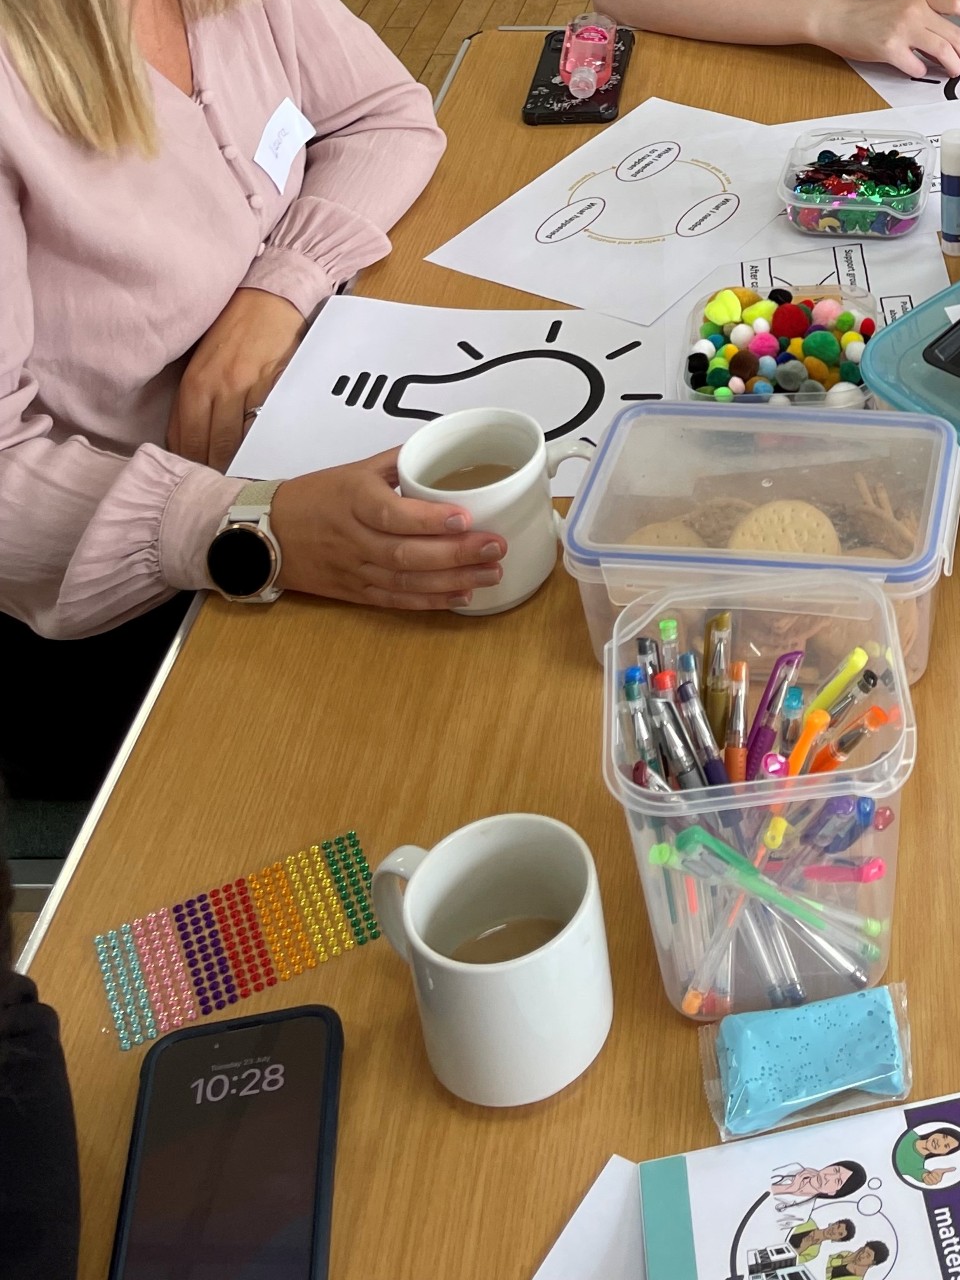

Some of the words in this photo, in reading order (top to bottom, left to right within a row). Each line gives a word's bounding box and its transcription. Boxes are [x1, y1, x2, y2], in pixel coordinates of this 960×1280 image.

[578, 200, 598, 217] What
[712, 196, 732, 214] What
[687, 212, 712, 233] needed
[844, 249, 855, 276] Support
[750, 265, 758, 281] After
[190, 1064, 284, 1104] 10:28
